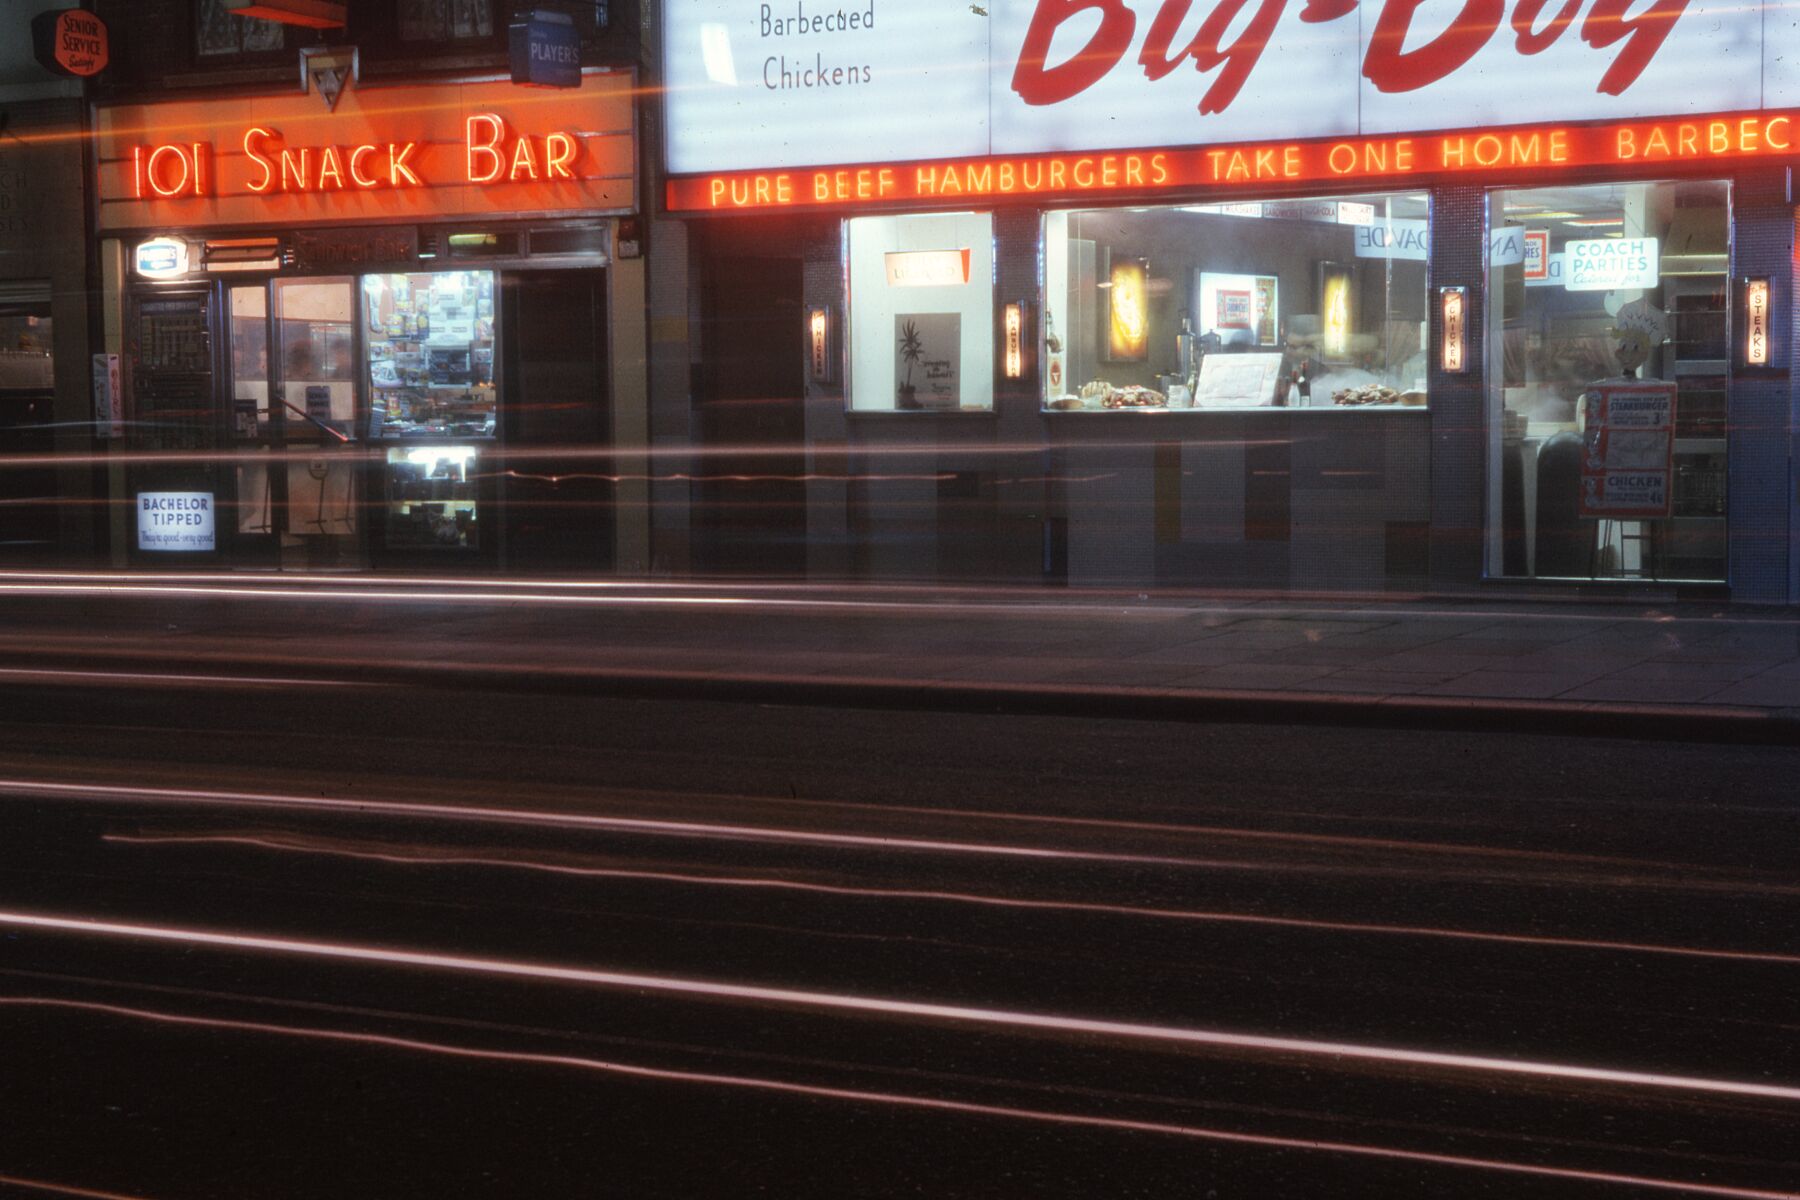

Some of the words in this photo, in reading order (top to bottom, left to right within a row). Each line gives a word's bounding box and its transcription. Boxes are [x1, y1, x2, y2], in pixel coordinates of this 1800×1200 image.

[760, 0, 874, 37] Barbecued
[763, 52, 871, 90] Chickens
[709, 173, 792, 208] PURE
[813, 168, 895, 201] BEEF
[916, 153, 1168, 195] HAMBURGERS
[1206, 146, 1301, 182] TAKE
[1328, 140, 1414, 175] ONE
[1442, 130, 1569, 169] HOME
[1616, 116, 1791, 160] BARBEC
[1574, 241, 1645, 257] COACH
[1573, 256, 1648, 274] PARTIES
[1449, 305, 1457, 366] CHICKEN
[1753, 294, 1762, 358] STEAKS
[1607, 475, 1662, 487] CHICKEN
[142, 498, 209, 511] BACHELOR
[152, 513, 203, 526] TIPPED
